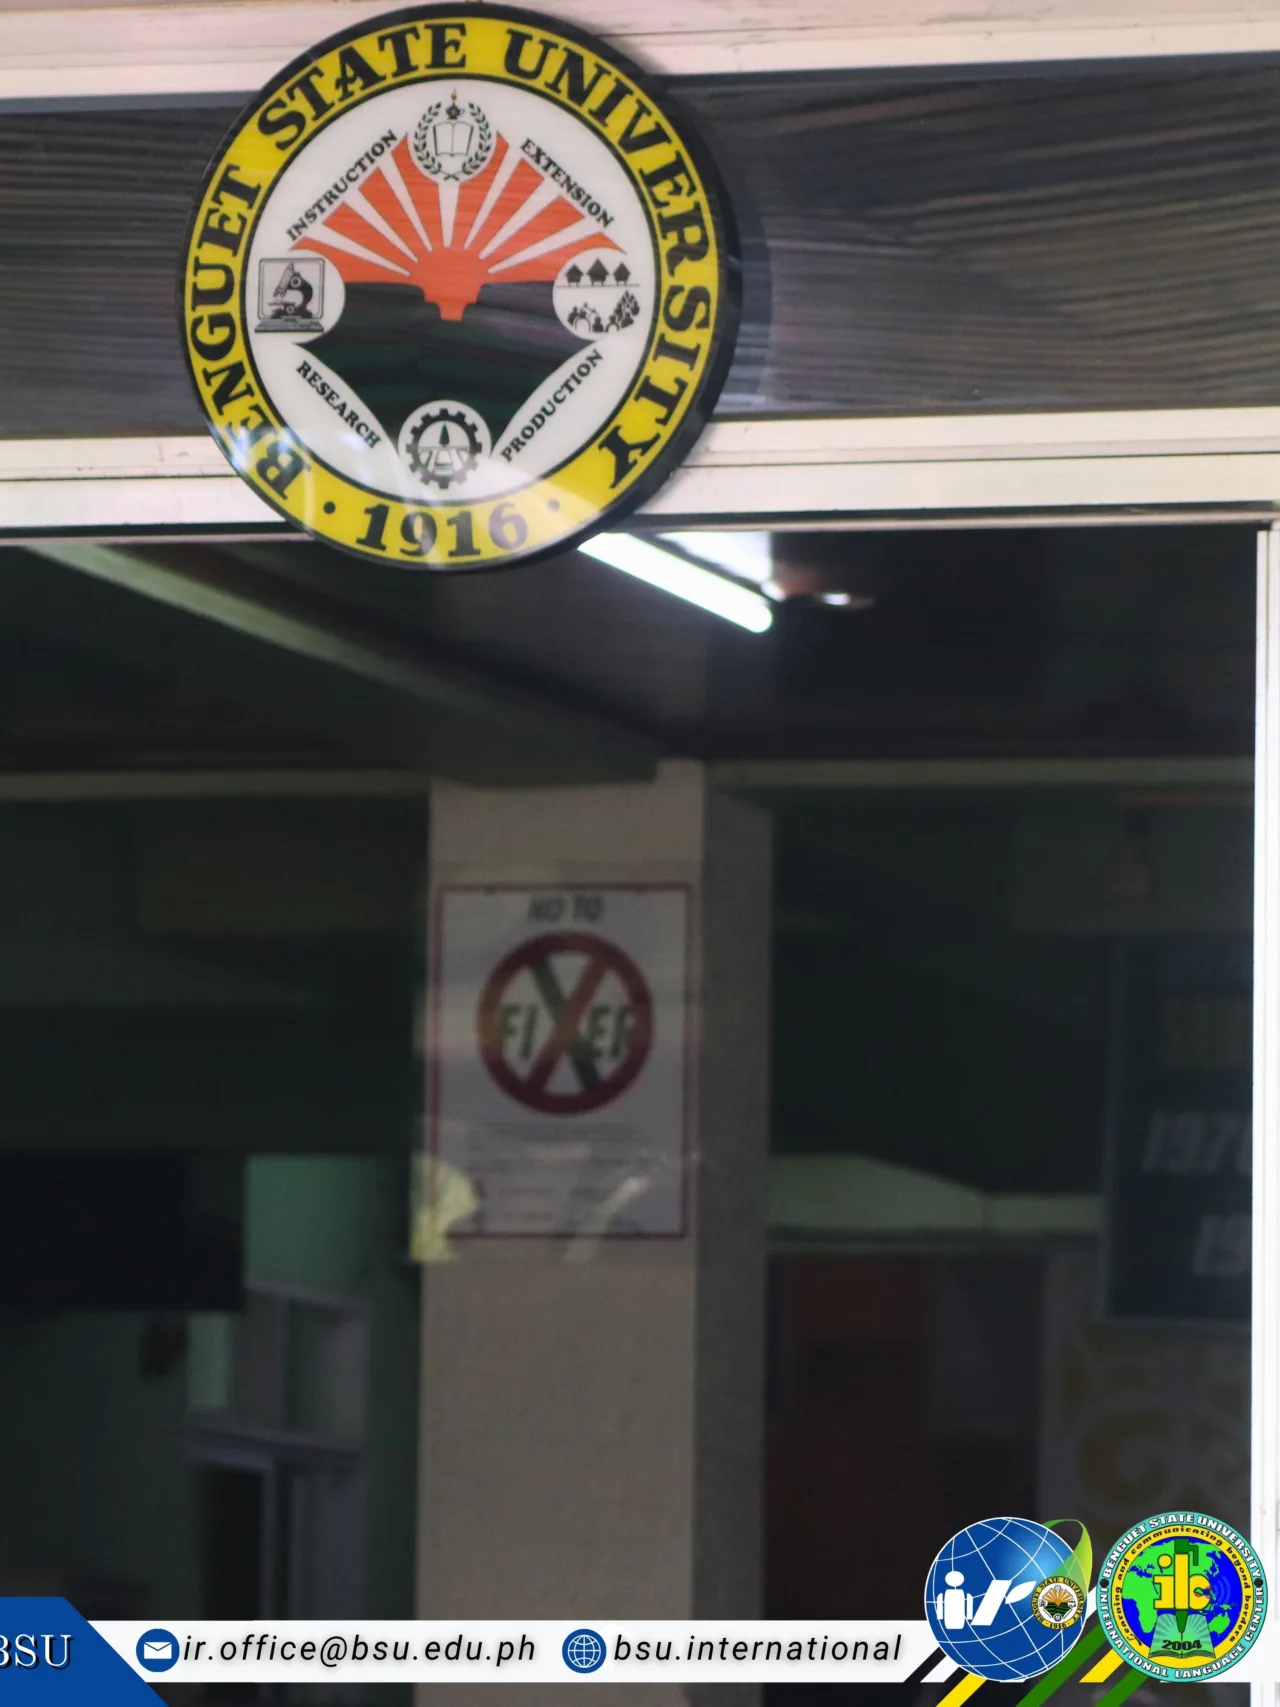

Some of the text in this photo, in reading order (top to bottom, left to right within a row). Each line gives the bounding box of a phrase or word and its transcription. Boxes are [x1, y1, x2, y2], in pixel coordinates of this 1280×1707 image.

[286, 129, 397, 242] INSTRUCTION
[520, 138, 615, 229] EXTENSION
[190, 23, 712, 499] BENGUET STATE UNIVERSITY
[296, 360, 381, 450] RESEARCH
[500, 349, 603, 462] PRODUCTION
[356, 503, 530, 558] 1916
[572, 894, 604, 921] TO
